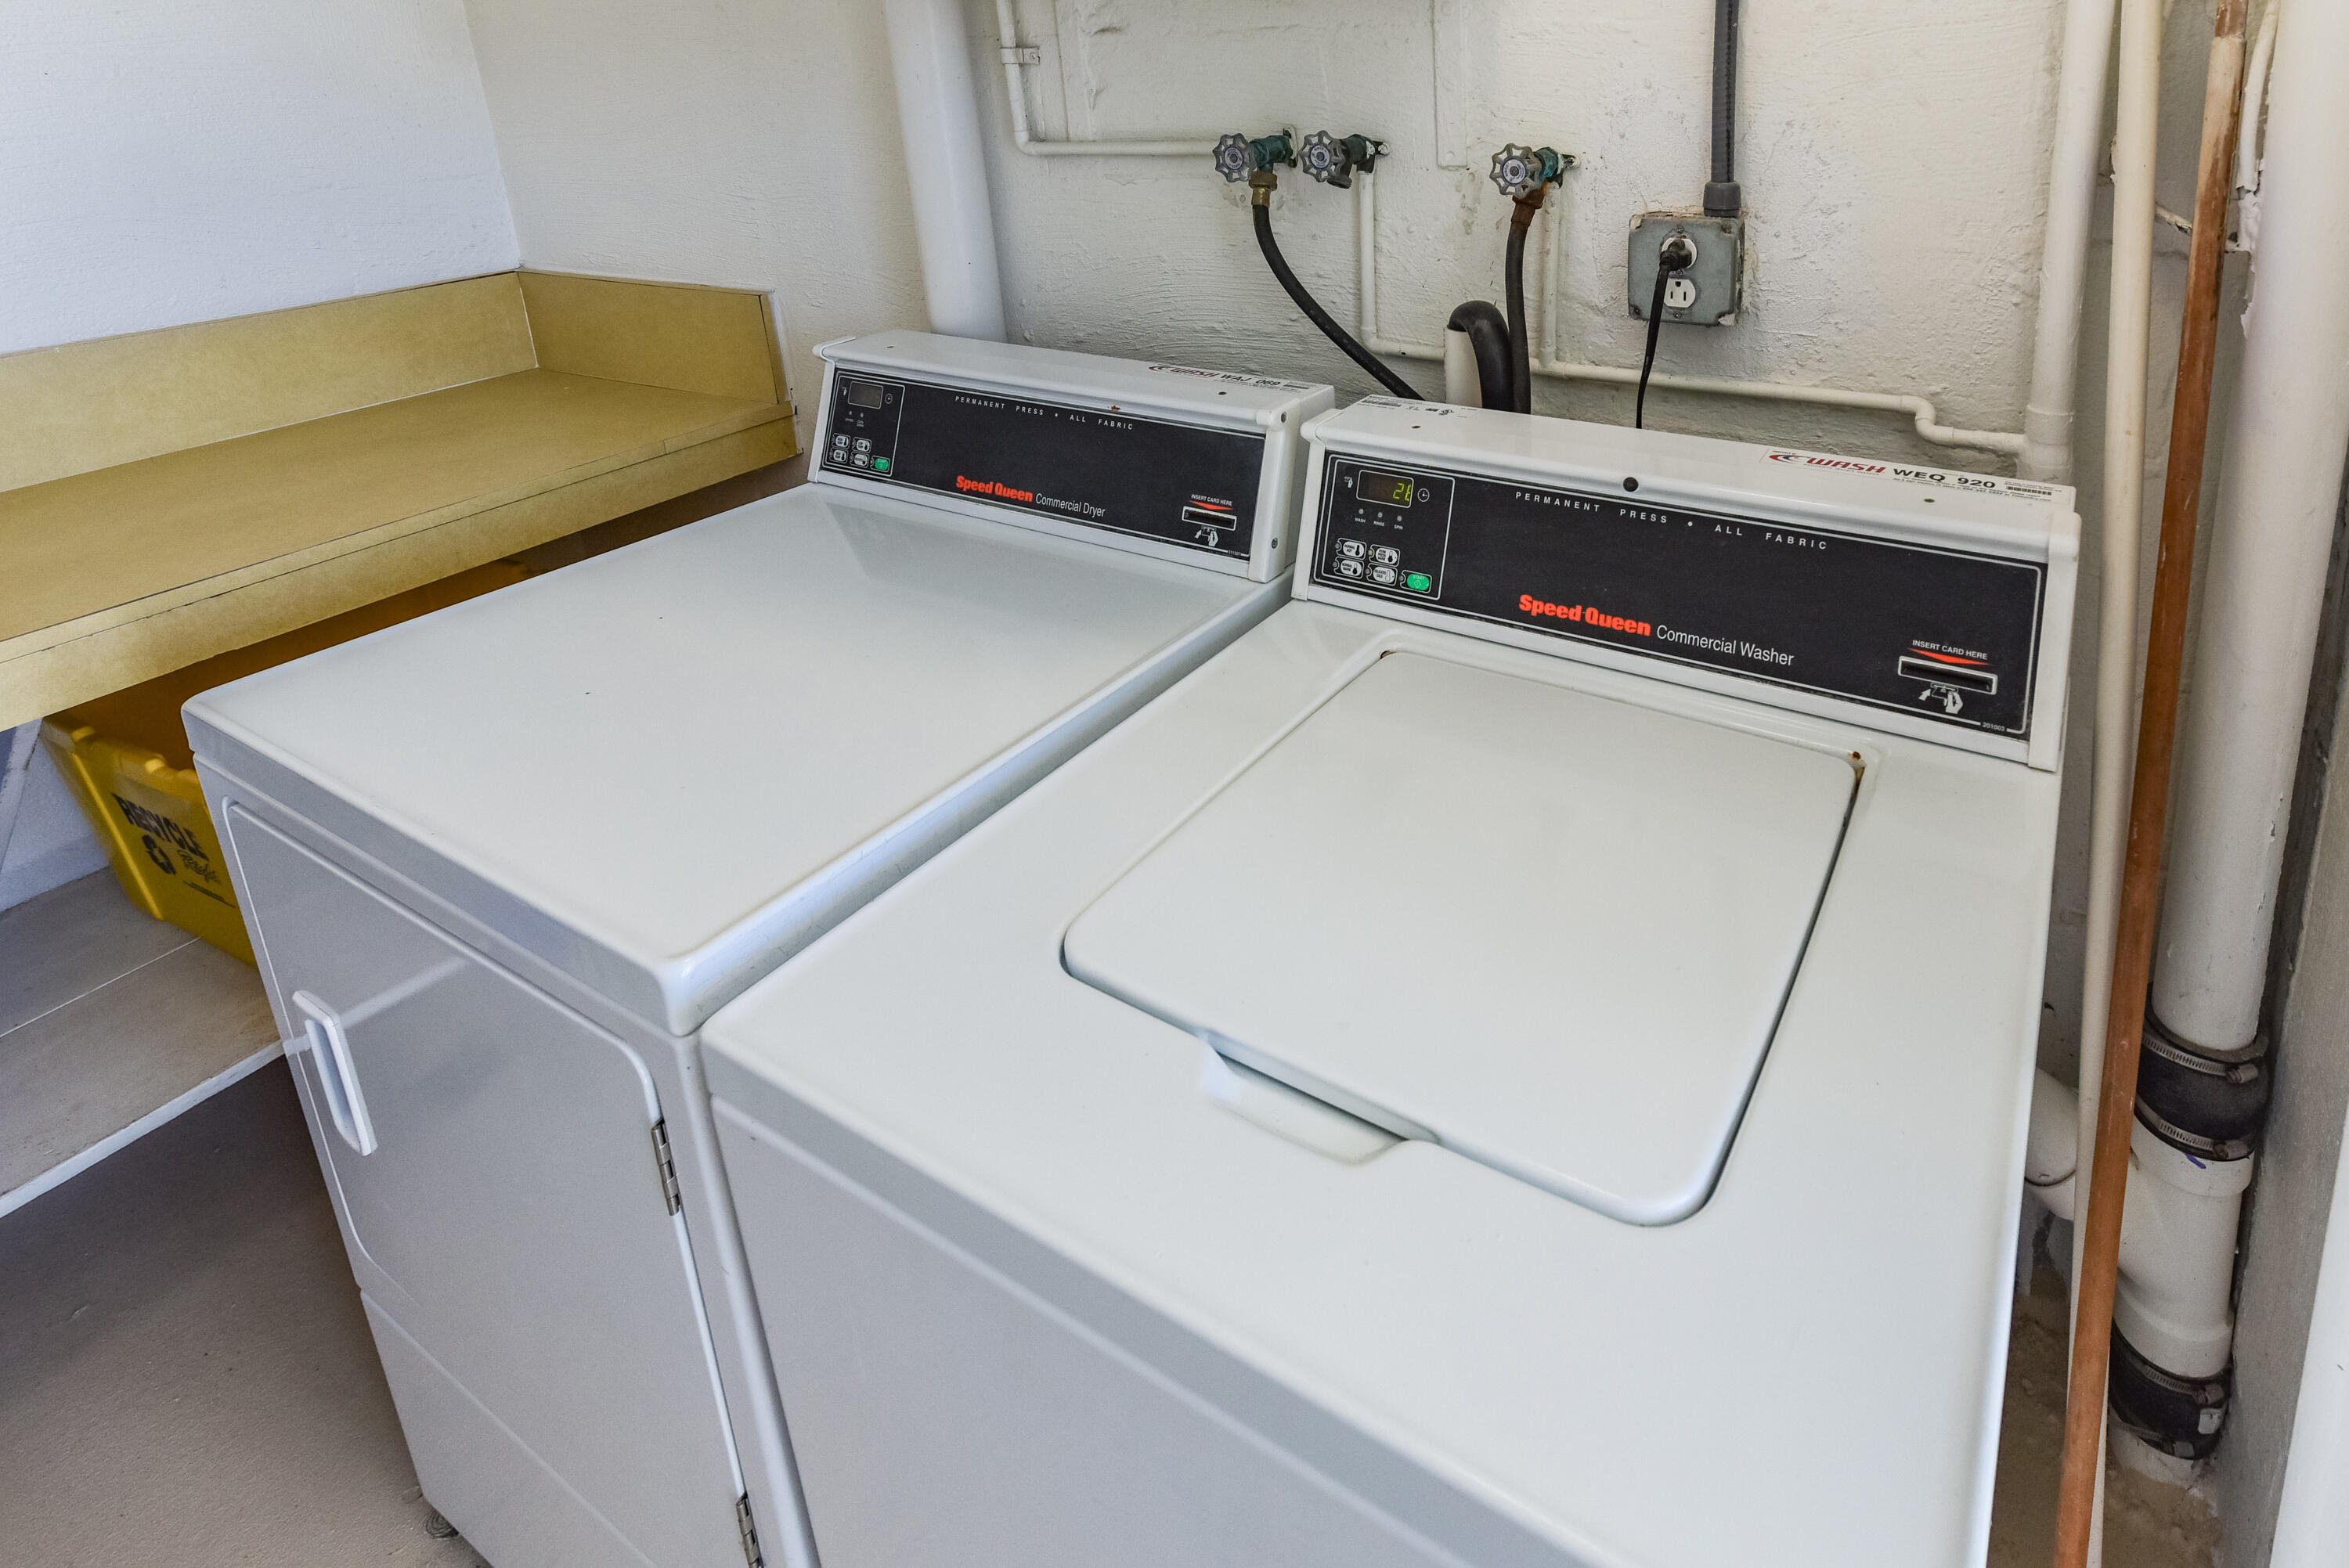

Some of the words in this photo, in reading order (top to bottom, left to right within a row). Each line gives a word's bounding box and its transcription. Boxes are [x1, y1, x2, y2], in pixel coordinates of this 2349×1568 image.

[1220, 373, 1252, 383] WAJ
[955, 395, 1005, 409] PERMANENT
[1016, 406, 1044, 416] PRESS
[1070, 414, 1086, 423] ALL
[1098, 419, 1134, 430] FABRIC
[1806, 457, 1886, 473] WASH
[1893, 468, 1946, 482] WEQ
[1958, 477, 1996, 488] 920
[956, 475, 994, 495] Speed
[994, 482, 1033, 502] Queen
[1035, 493, 1081, 512] Commercial
[1083, 503, 1106, 518] Dryer
[1515, 492, 1601, 513] PERMANENT
[1619, 508, 1668, 524] PRESS
[1715, 524, 1744, 536] ALL
[1765, 532, 1828, 550] FABRIC
[1519, 594, 1582, 622] Speed
[1585, 607, 1651, 636] Queen
[1656, 625, 1736, 654] Commercial
[1740, 642, 1794, 666] Washer
[1912, 640, 1941, 651] INSERT
[1942, 645, 1965, 655] CARD
[1965, 650, 1988, 660] HERE
